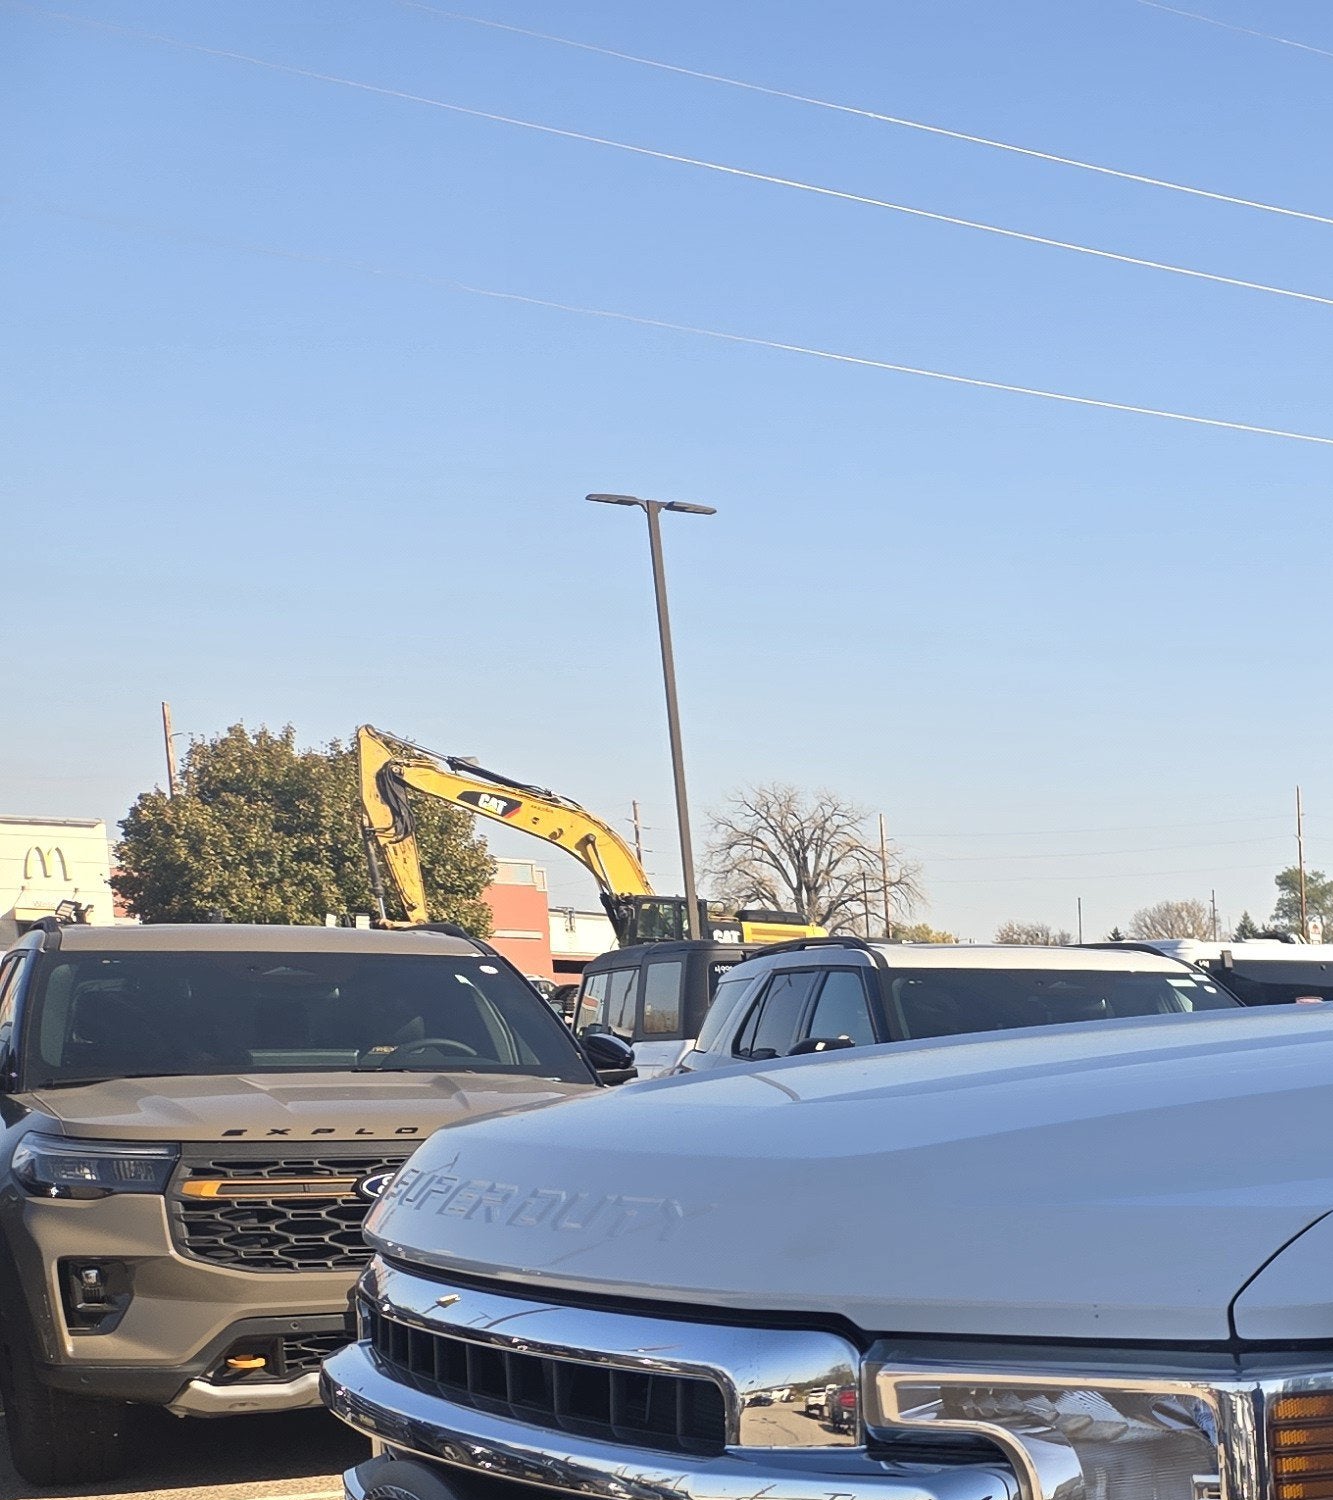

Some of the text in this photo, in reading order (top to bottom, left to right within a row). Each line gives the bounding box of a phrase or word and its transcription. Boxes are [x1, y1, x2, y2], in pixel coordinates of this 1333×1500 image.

[478, 793, 508, 816] CAT
[713, 929, 740, 943] CAT
[221, 1127, 419, 1137] EXPLO
[382, 1167, 688, 1241] SUPER DUTY
